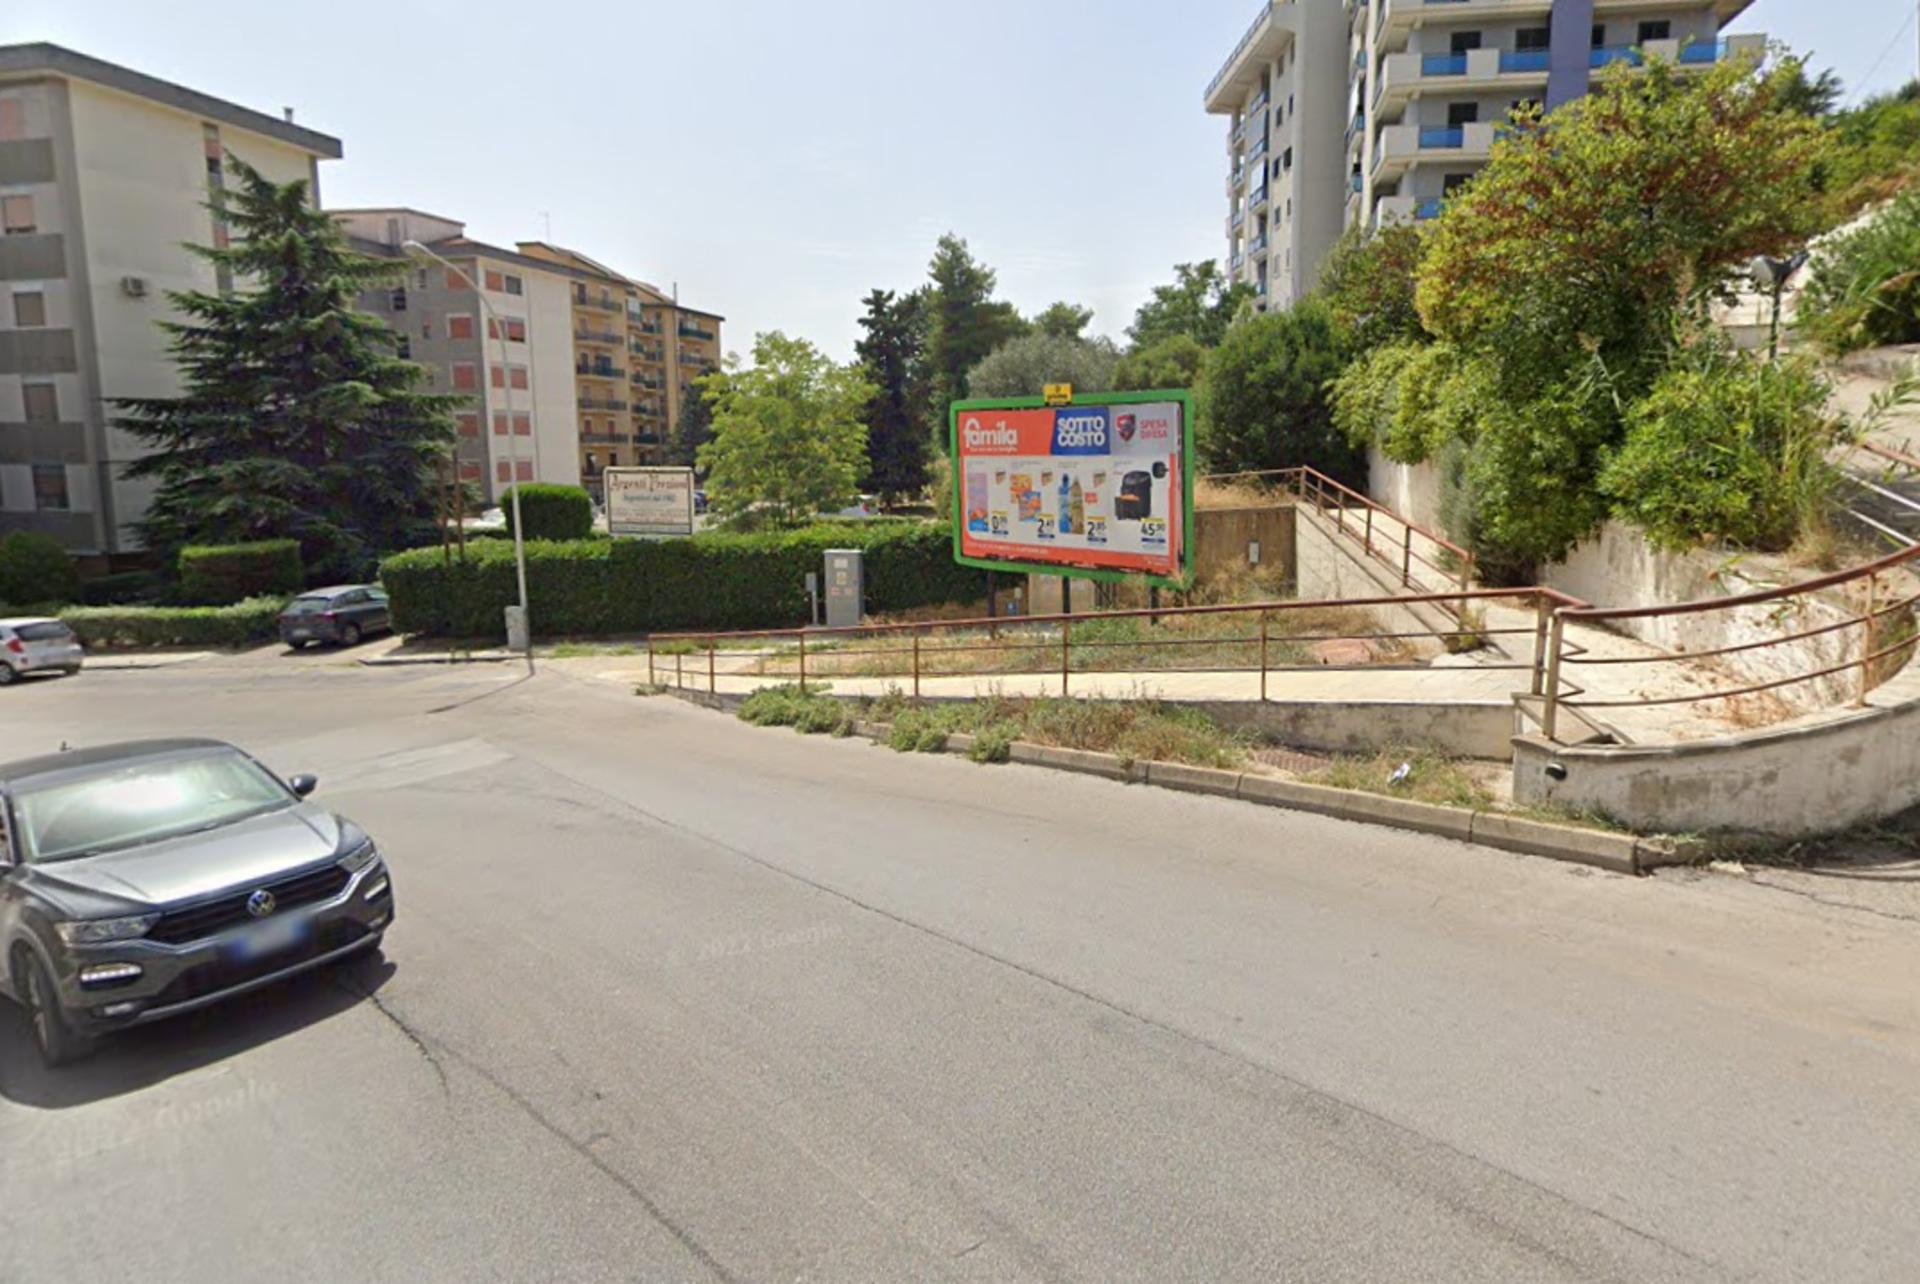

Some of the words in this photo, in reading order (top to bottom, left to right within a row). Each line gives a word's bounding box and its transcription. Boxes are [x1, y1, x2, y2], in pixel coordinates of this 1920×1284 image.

[1057, 416, 1105, 432] SOTTO
[1140, 419, 1168, 430] SPESA
[963, 418, 1018, 448] famila
[1057, 431, 1106, 447] COSTO
